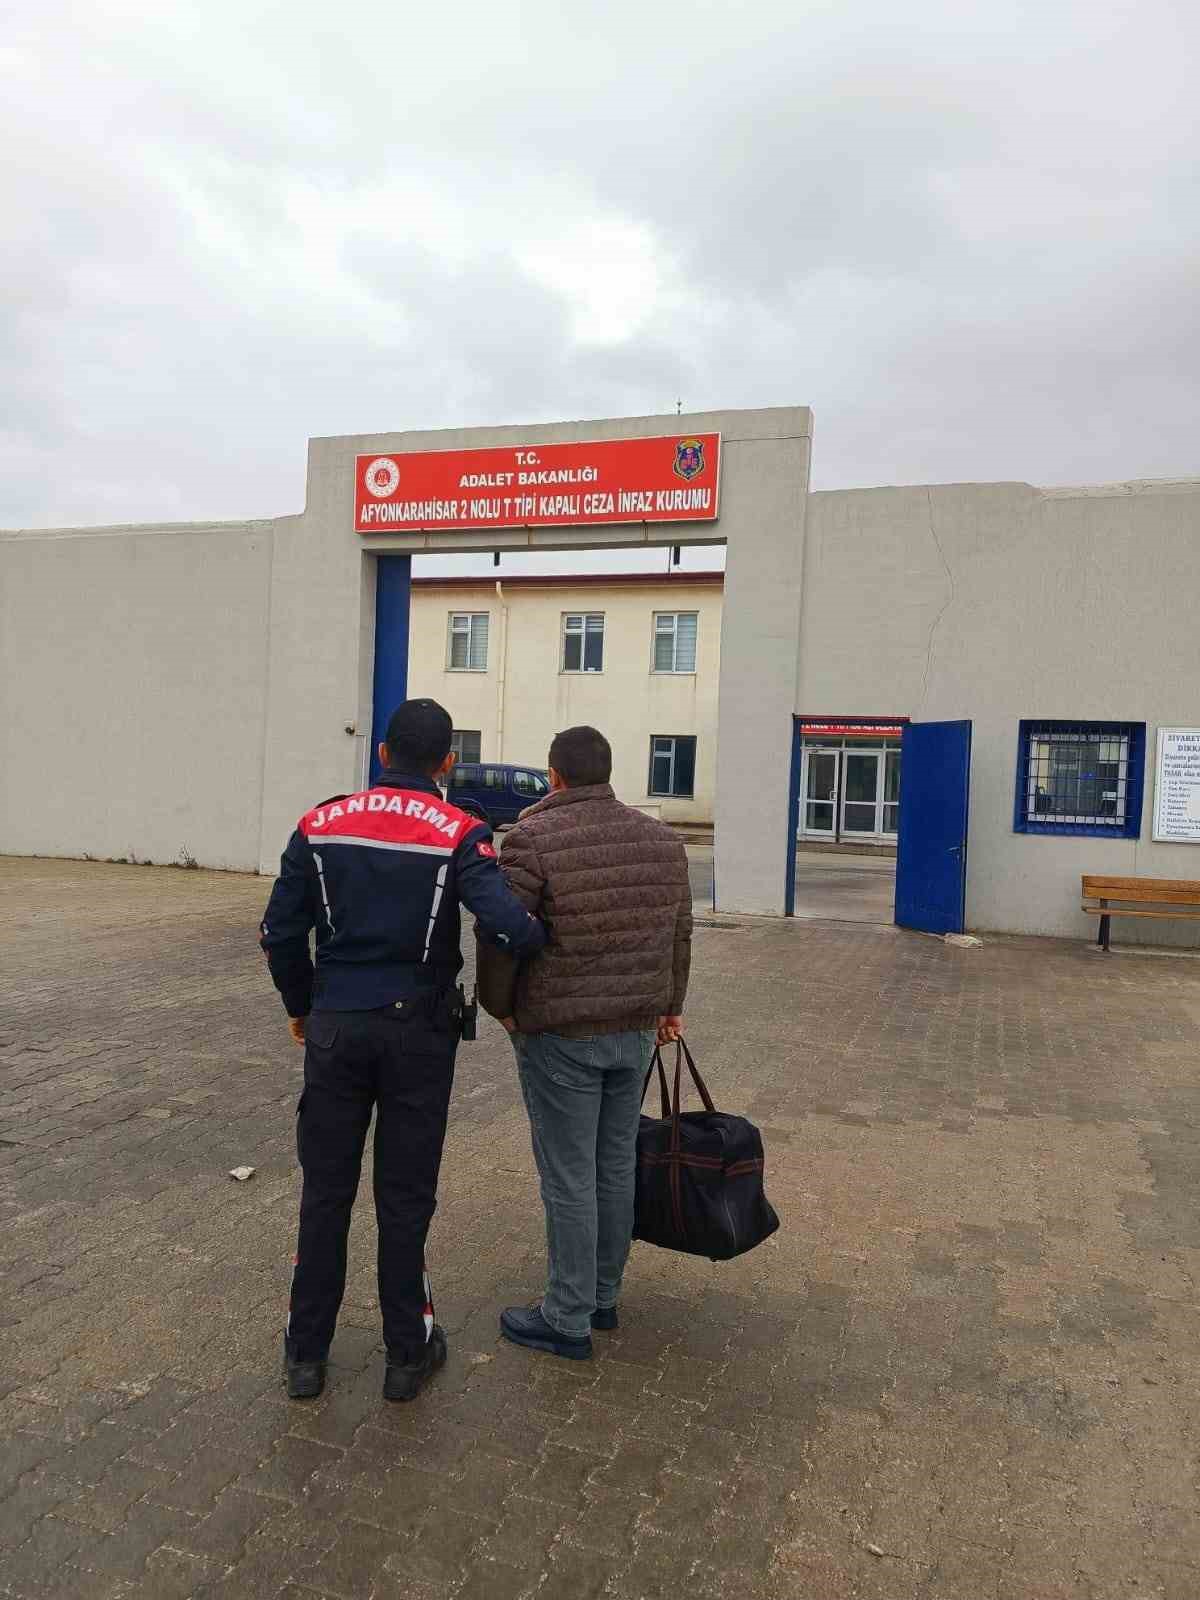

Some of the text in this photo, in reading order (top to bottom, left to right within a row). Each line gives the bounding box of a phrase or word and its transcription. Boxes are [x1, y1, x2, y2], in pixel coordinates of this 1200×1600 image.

[515, 451, 541, 465] T.C.
[459, 466, 598, 488] ADALET BAKANLIĞI
[360, 487, 711, 523] AFYONKARAHİSAR 2 NOLU T TİPİ KAPALI CEZA İNFAZ KURUMU
[311, 794, 461, 839] JANDARMA
